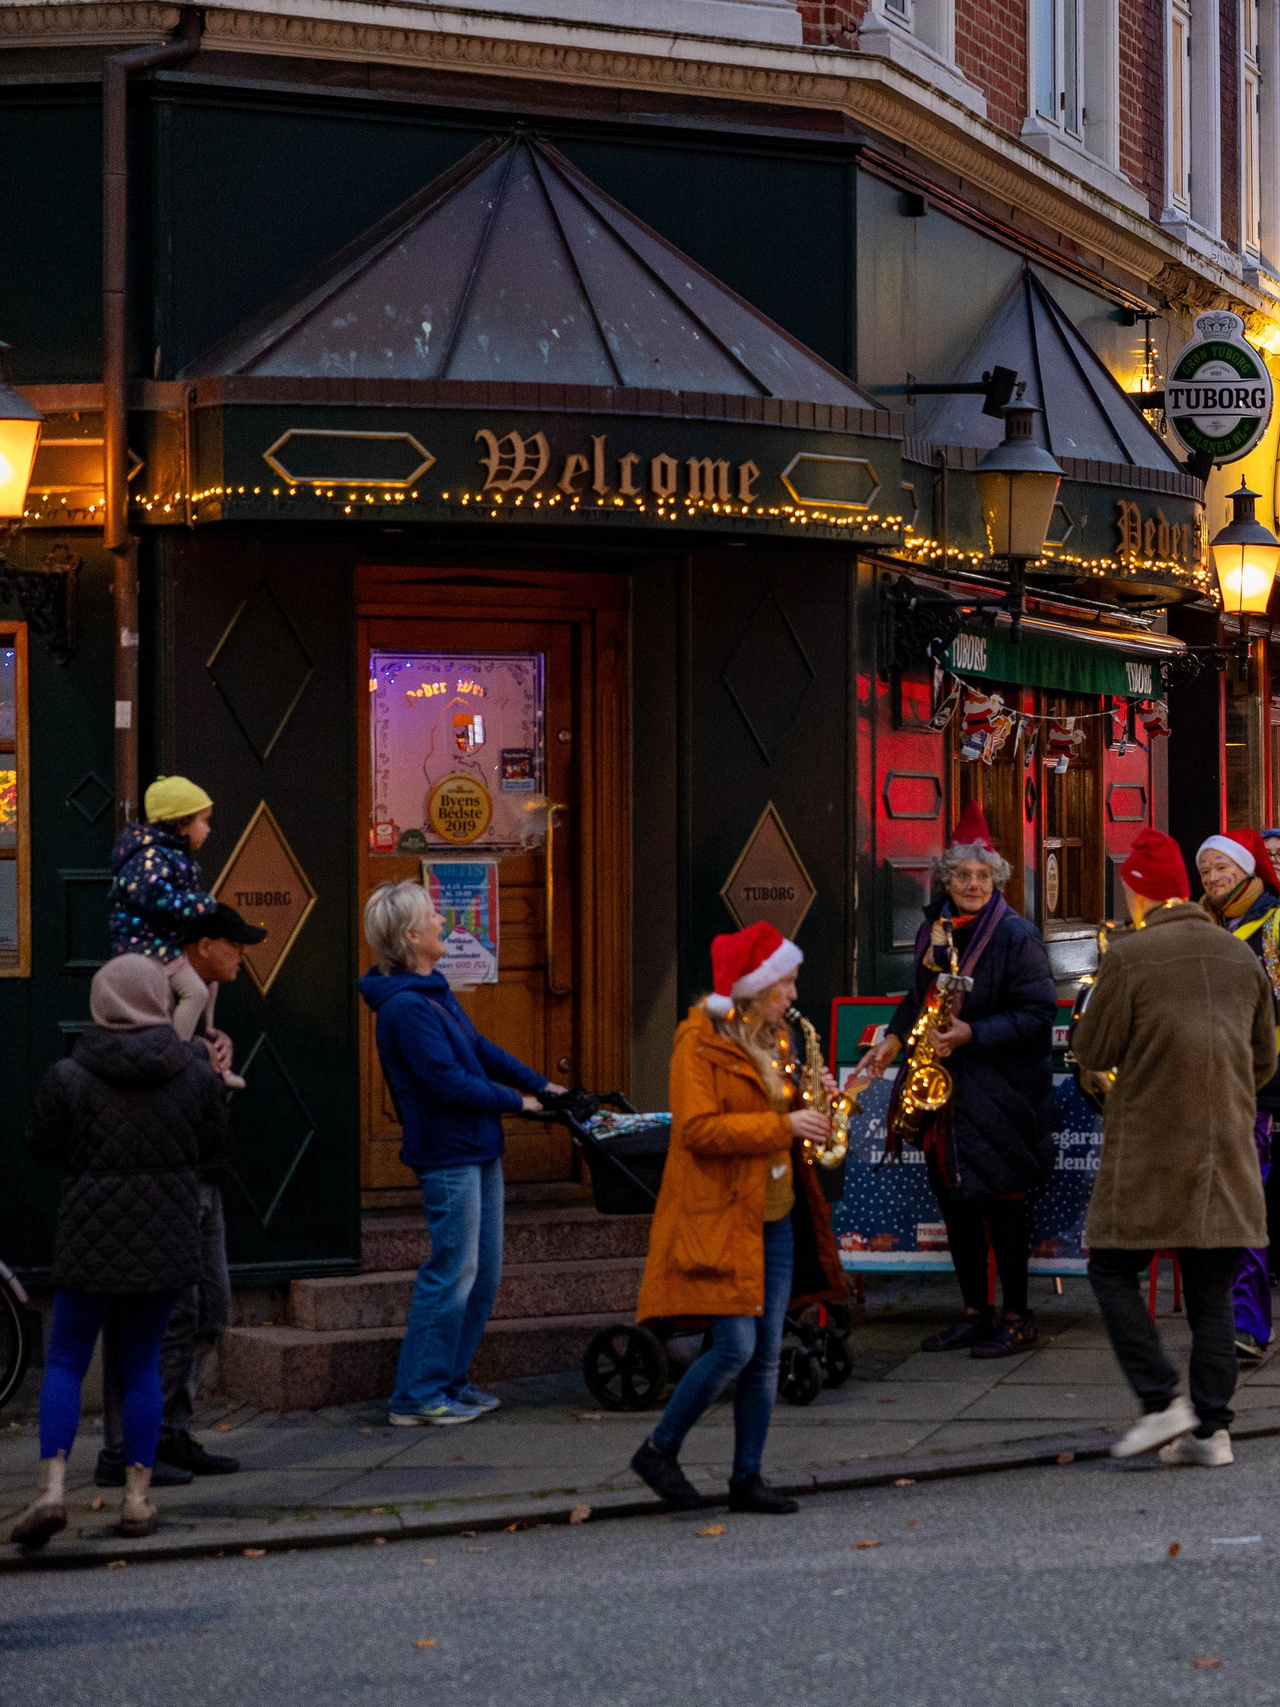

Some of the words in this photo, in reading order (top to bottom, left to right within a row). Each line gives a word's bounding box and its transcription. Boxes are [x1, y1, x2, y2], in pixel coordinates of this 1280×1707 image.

[1182, 348, 1208, 375] GRØN
[1211, 346, 1251, 374] TUBORG
[1169, 387, 1266, 409] TUBORG
[1186, 431, 1234, 453] PILSNER
[1234, 428, 1248, 445] ØL
[474, 428, 761, 504] Welcome
[1115, 500, 1191, 561] Peder
[440, 794, 480, 807] Byens
[438, 807, 482, 819] Bedste
[445, 819, 476, 832] 2019
[234, 891, 292, 907] TUBORG
[743, 886, 795, 901] TUBORG
